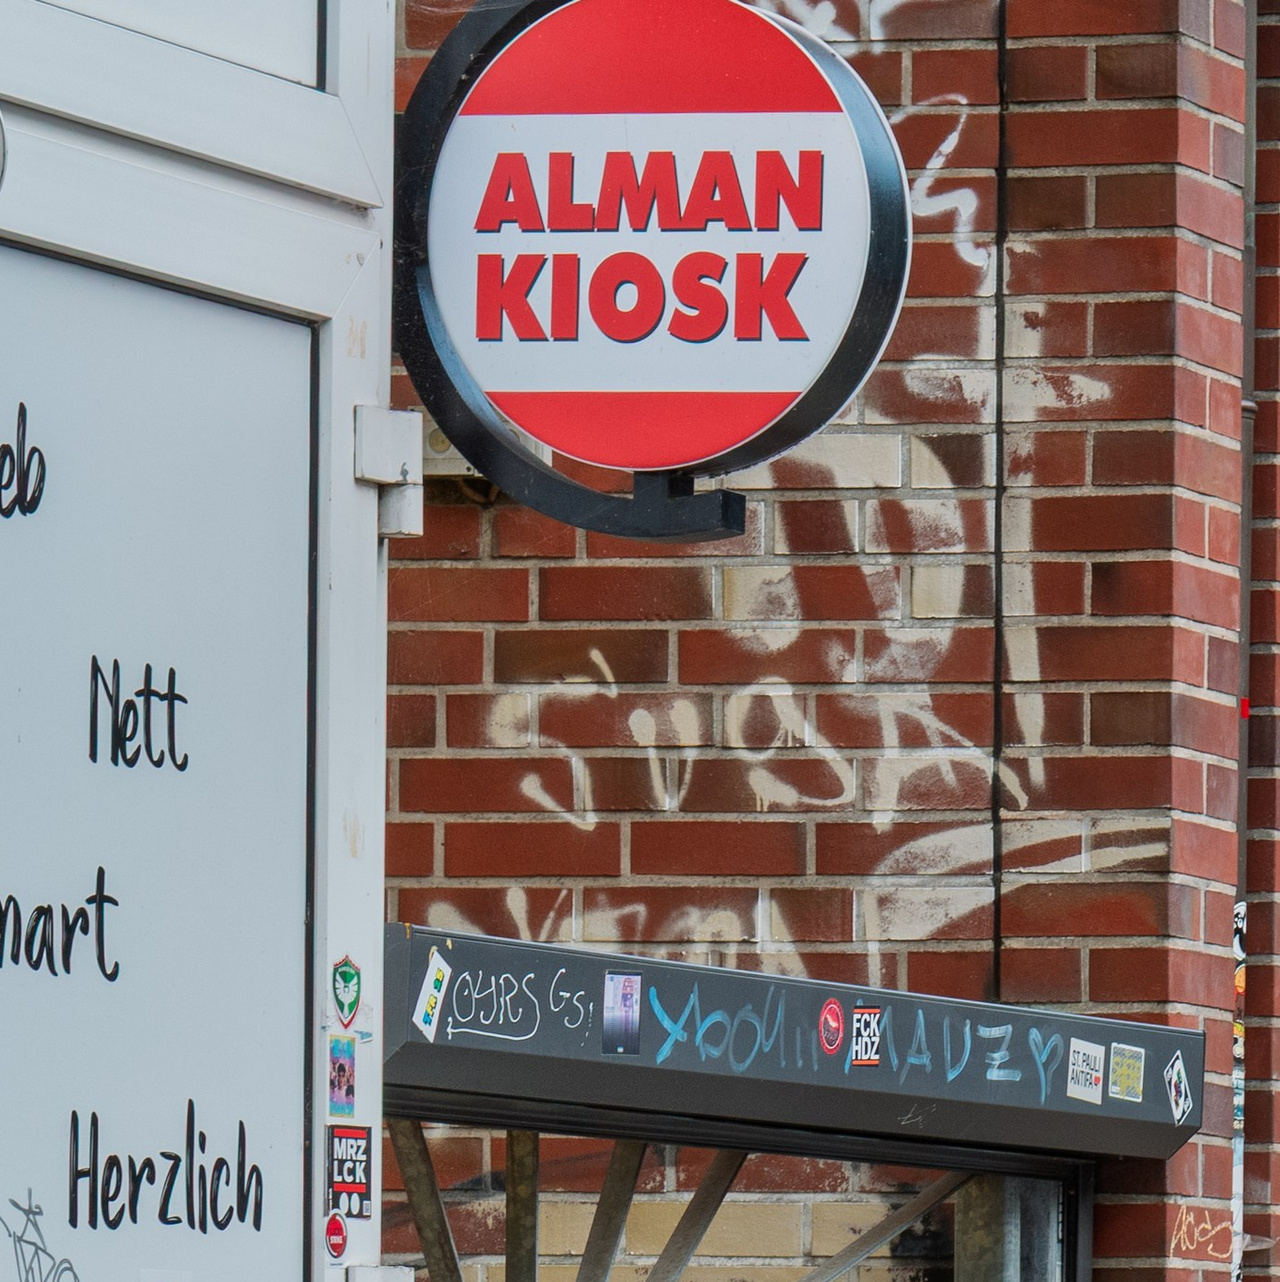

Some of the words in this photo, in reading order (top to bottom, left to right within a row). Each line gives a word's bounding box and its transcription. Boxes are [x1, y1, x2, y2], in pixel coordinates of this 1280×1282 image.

[473, 149, 825, 233] ALMAN
[475, 251, 810, 343] KIOSK
[88, 655, 189, 772] Nett
[852, 1013, 880, 1036] FCK
[851, 1036, 880, 1060] HDZ
[1071, 1049, 1082, 1068] ST.
[1082, 1051, 1102, 1071] PAULI
[1070, 1068, 1093, 1088] ANTIFA
[333, 1138, 367, 1160] MRZ
[67, 1098, 264, 1234] Herzlich
[333, 1160, 367, 1183] LCK
